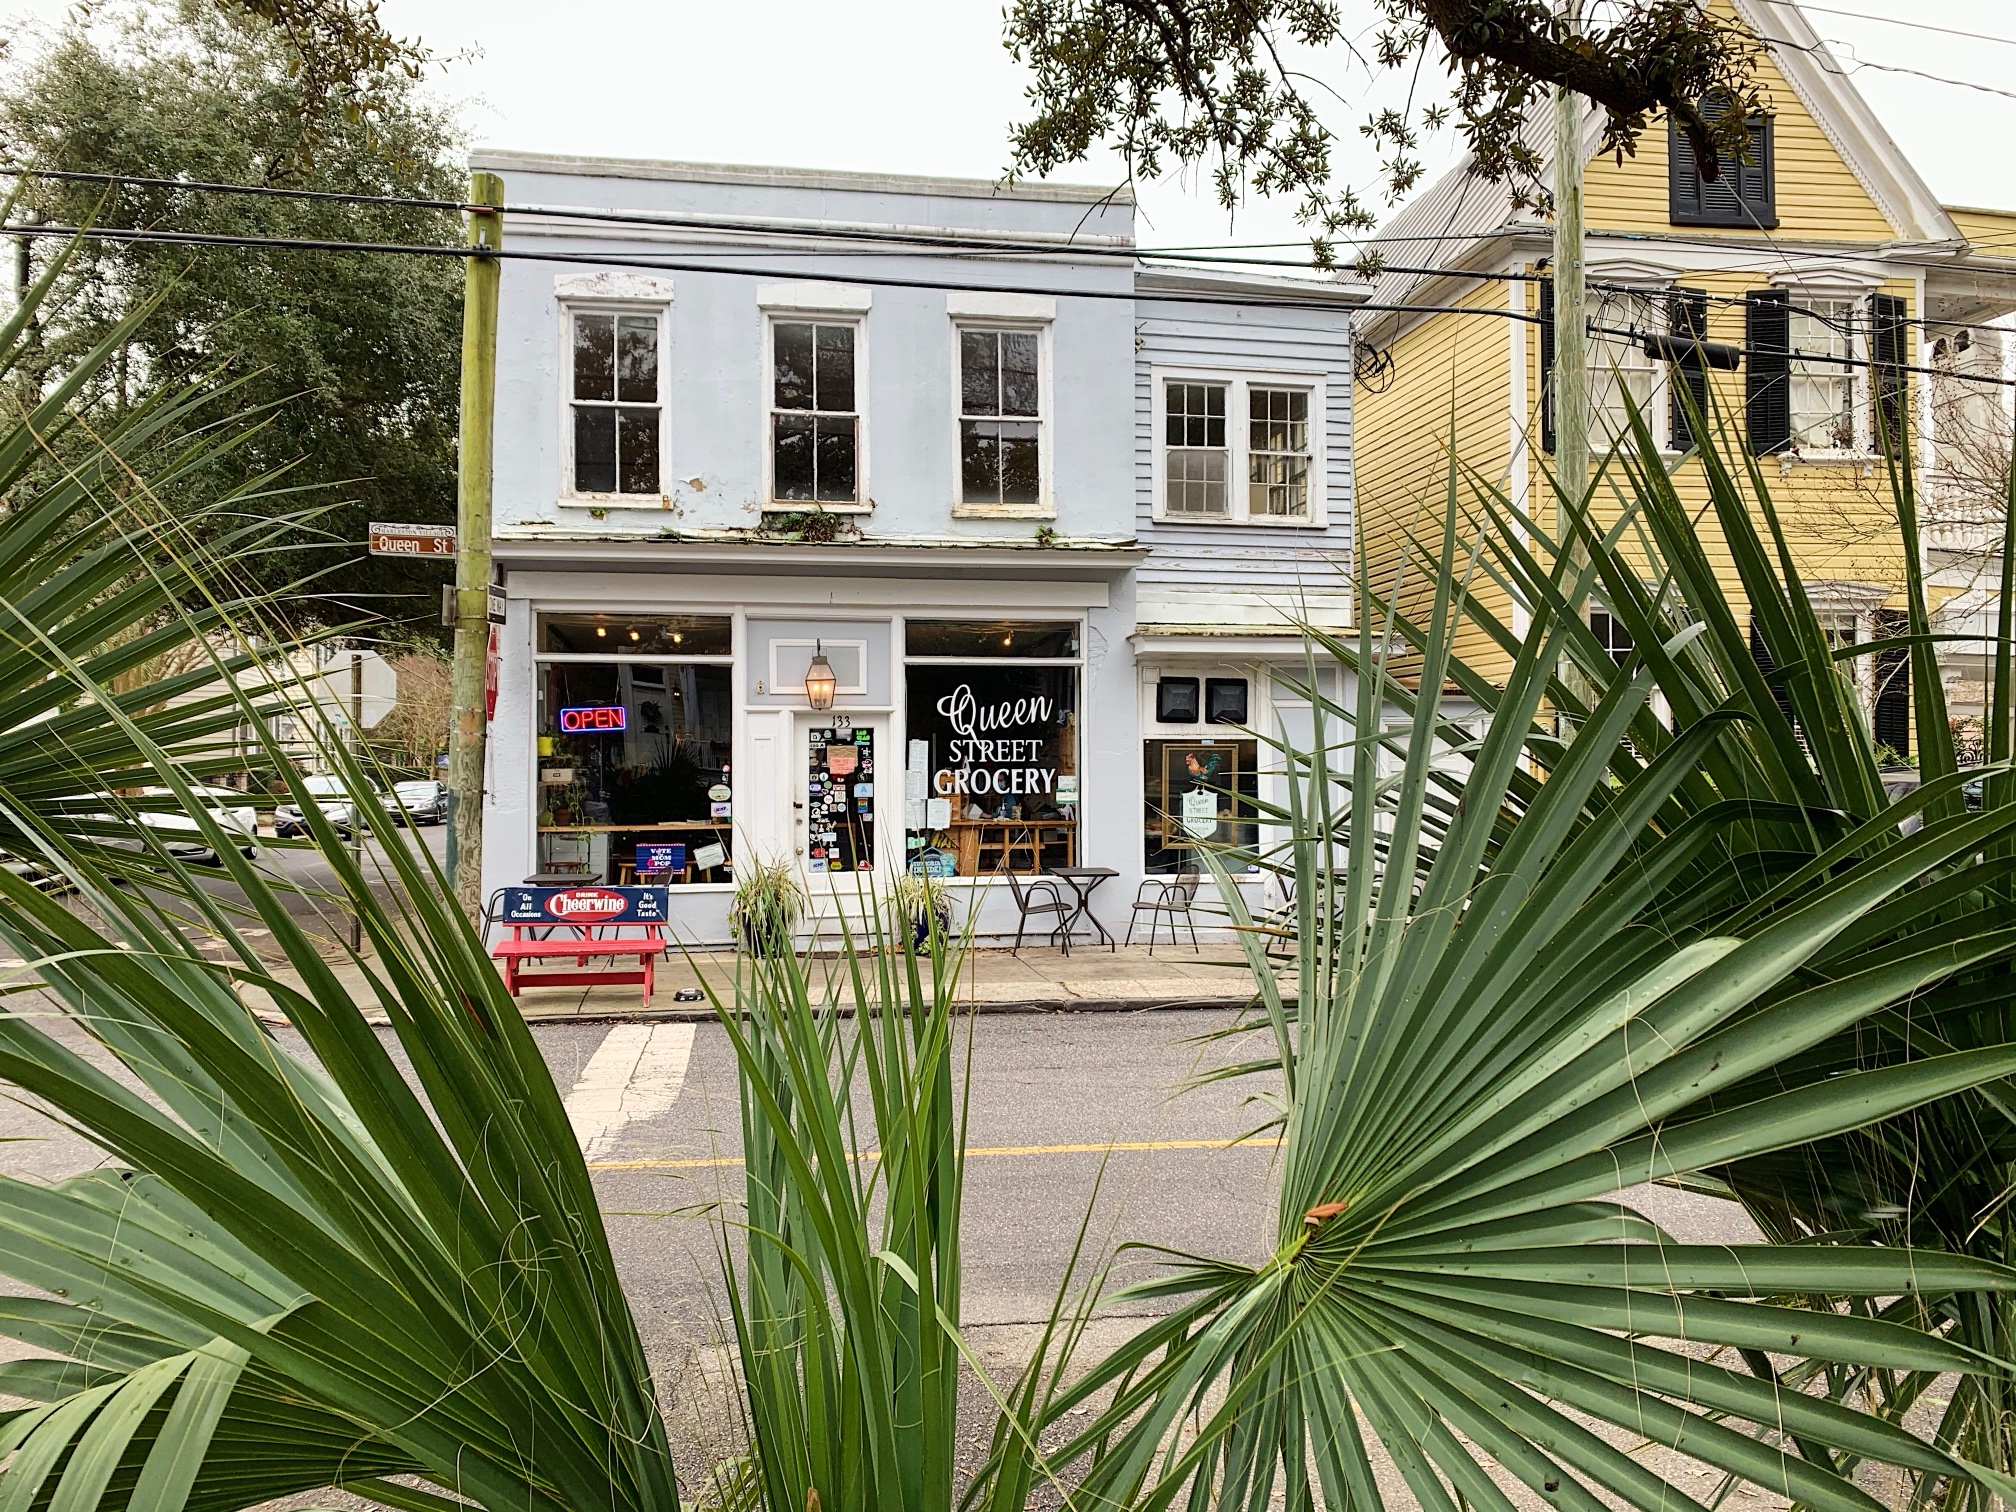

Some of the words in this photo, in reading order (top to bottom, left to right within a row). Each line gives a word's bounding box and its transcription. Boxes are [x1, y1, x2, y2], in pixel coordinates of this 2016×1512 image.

[379, 536, 420, 552] Queen
[433, 538, 448, 553] St
[564, 709, 623, 729] OPEN
[832, 715, 851, 728] 133
[936, 684, 1053, 750] Queen
[948, 739, 1044, 762] STREET
[933, 768, 1056, 795] GROCERY
[550, 893, 625, 916] Cheerwine
[638, 901, 657, 909] Good
[643, 892, 654, 900] It's
